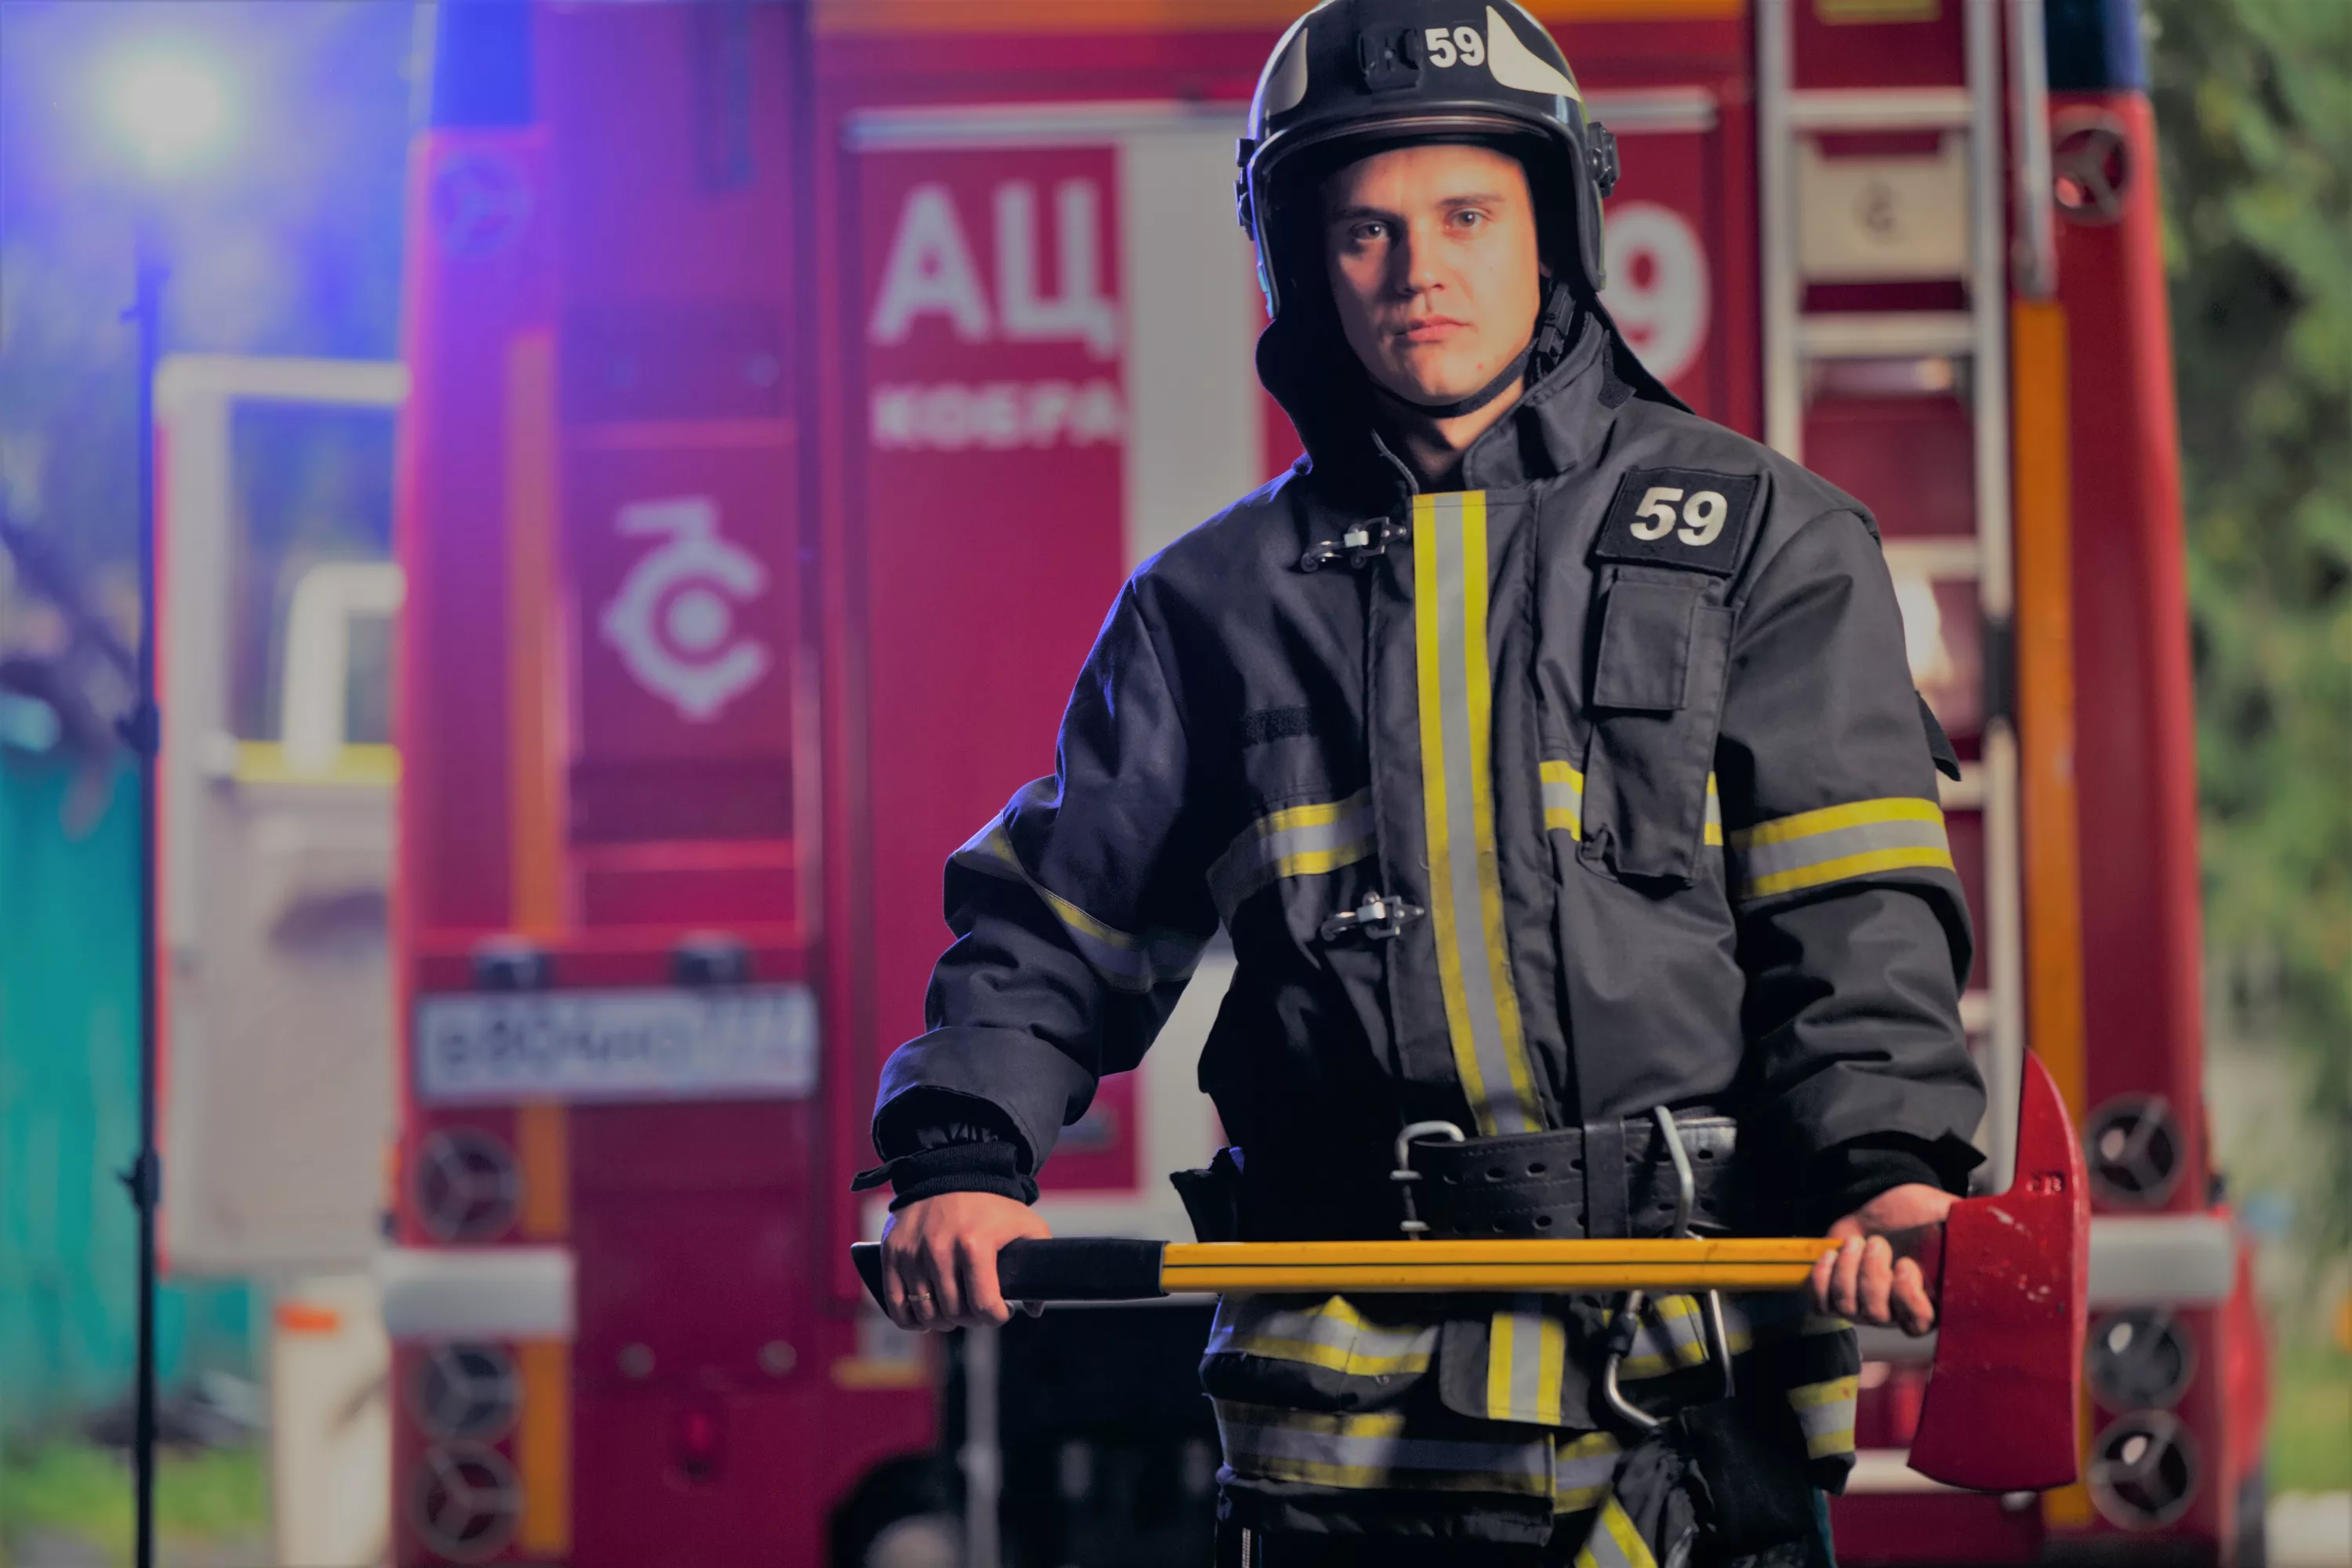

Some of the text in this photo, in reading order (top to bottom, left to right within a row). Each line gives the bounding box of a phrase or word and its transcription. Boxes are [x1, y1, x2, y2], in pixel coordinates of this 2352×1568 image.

[1425, 26, 1486, 68] 59
[869, 181, 1116, 358] АЦ
[1630, 487, 1728, 546] 59
